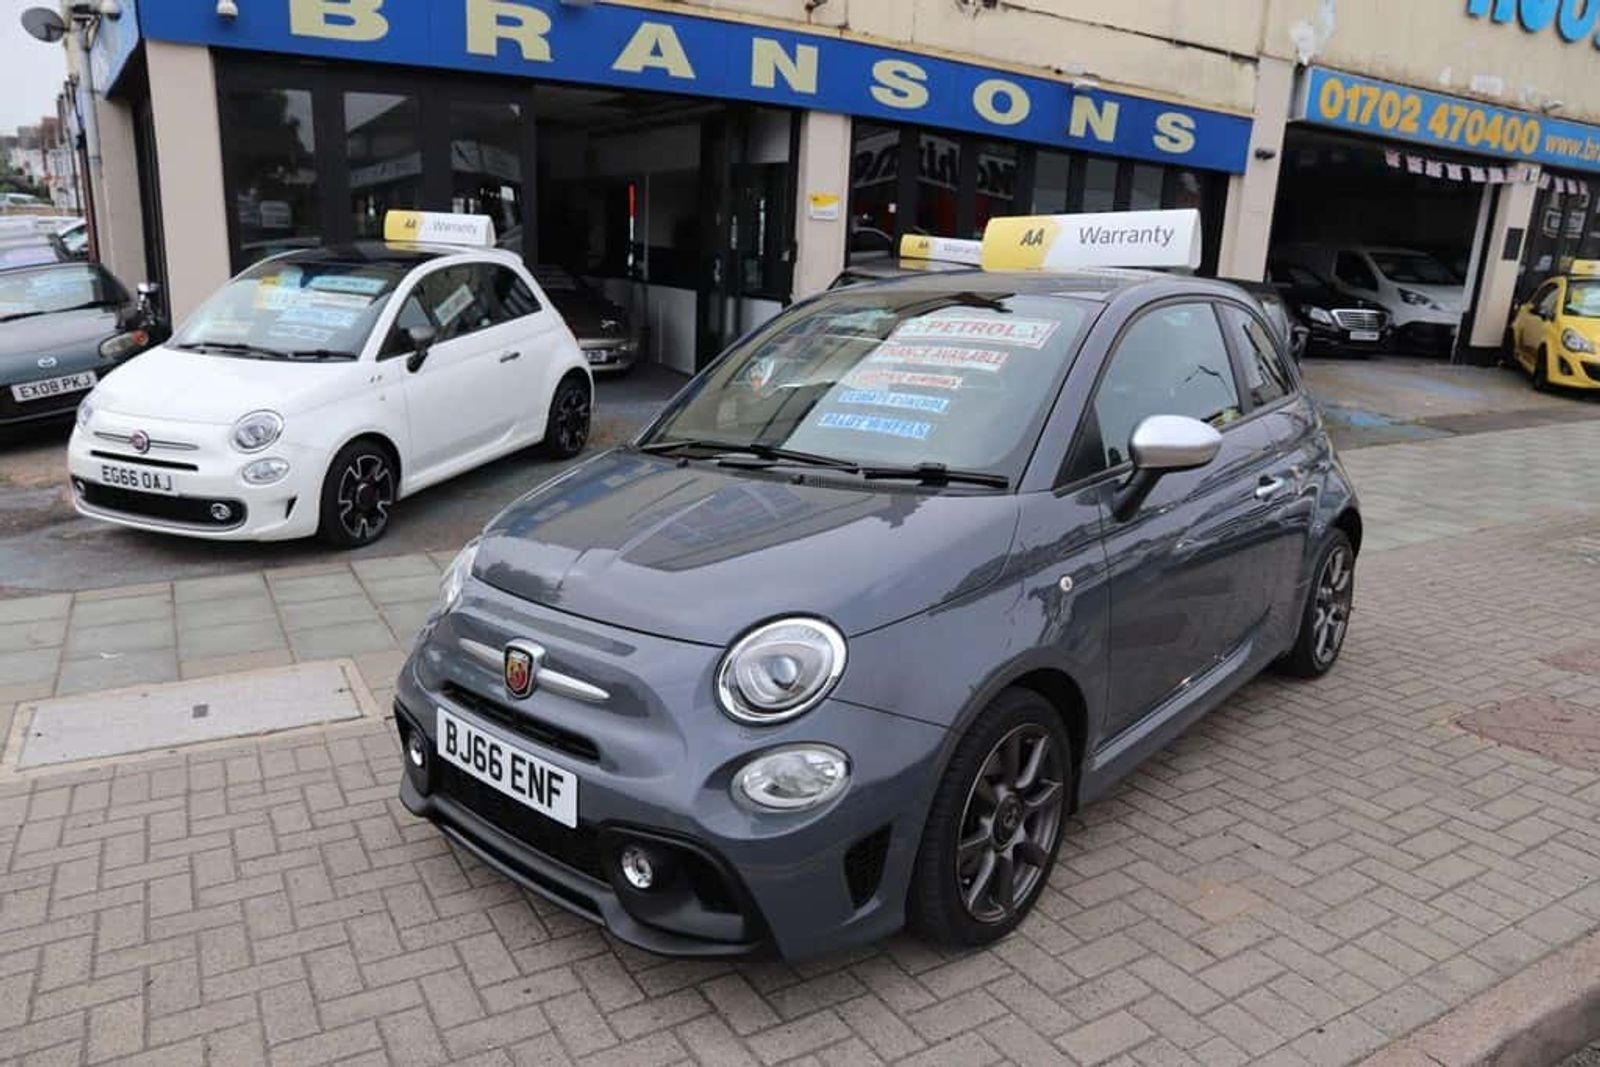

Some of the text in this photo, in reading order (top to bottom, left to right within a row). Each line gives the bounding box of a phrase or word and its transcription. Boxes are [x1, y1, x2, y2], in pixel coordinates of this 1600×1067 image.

[289, 0, 1197, 154] BRANSONS
[1319, 78, 1600, 162] 01702 470400 www.b
[1019, 224, 1176, 248] AA Warranty
[926, 319, 1017, 338] PETROL
[19, 374, 92, 398] EX08 PKJ
[101, 465, 173, 491] EG66 OAJ
[445, 719, 564, 810] BJ66 ENF
